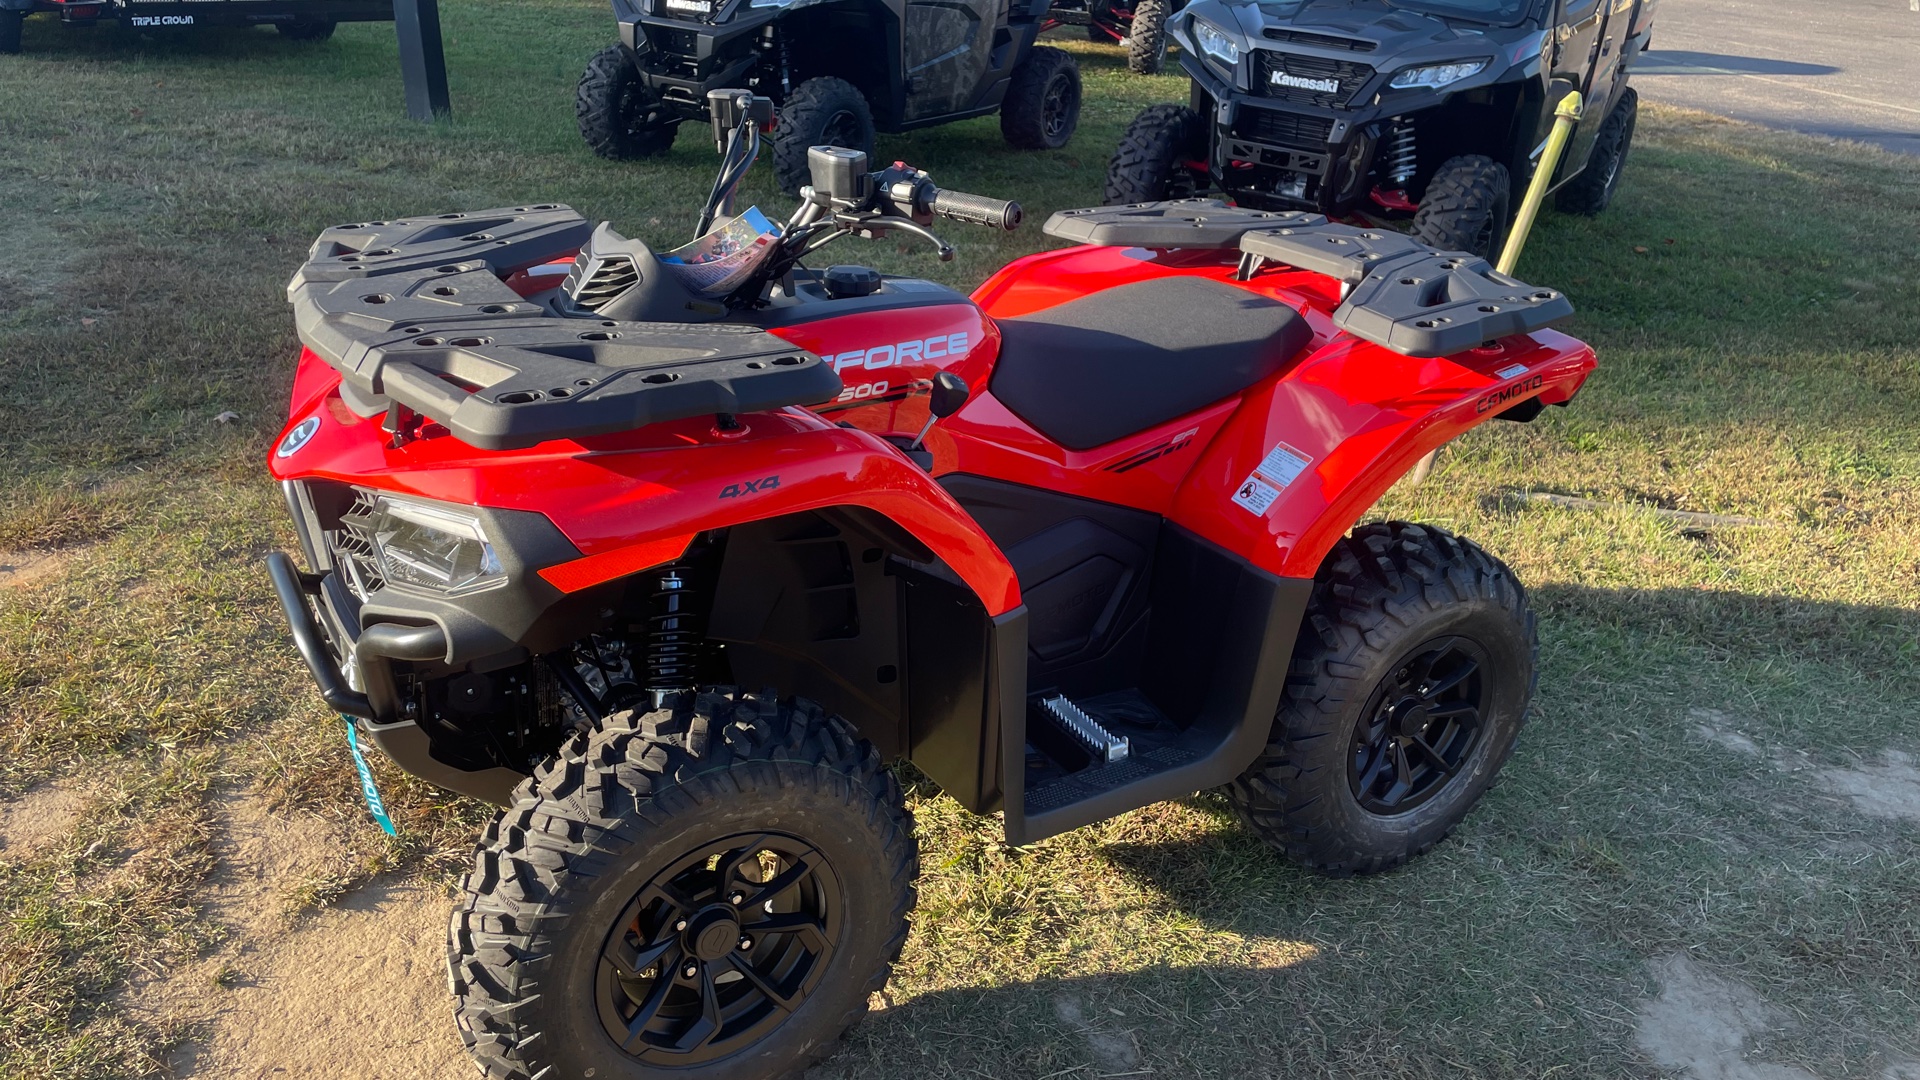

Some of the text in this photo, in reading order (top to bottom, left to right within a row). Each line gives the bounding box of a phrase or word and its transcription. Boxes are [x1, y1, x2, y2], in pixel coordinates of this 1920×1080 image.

[666, 0, 711, 13] Kawasaki
[131, 15, 194, 26] TRIPLE CROWN
[1270, 70, 1339, 93] Kawasaki
[837, 380, 889, 402] 500
[1476, 374, 1543, 414] CFMOTO
[353, 749, 384, 817] CFMOTO
